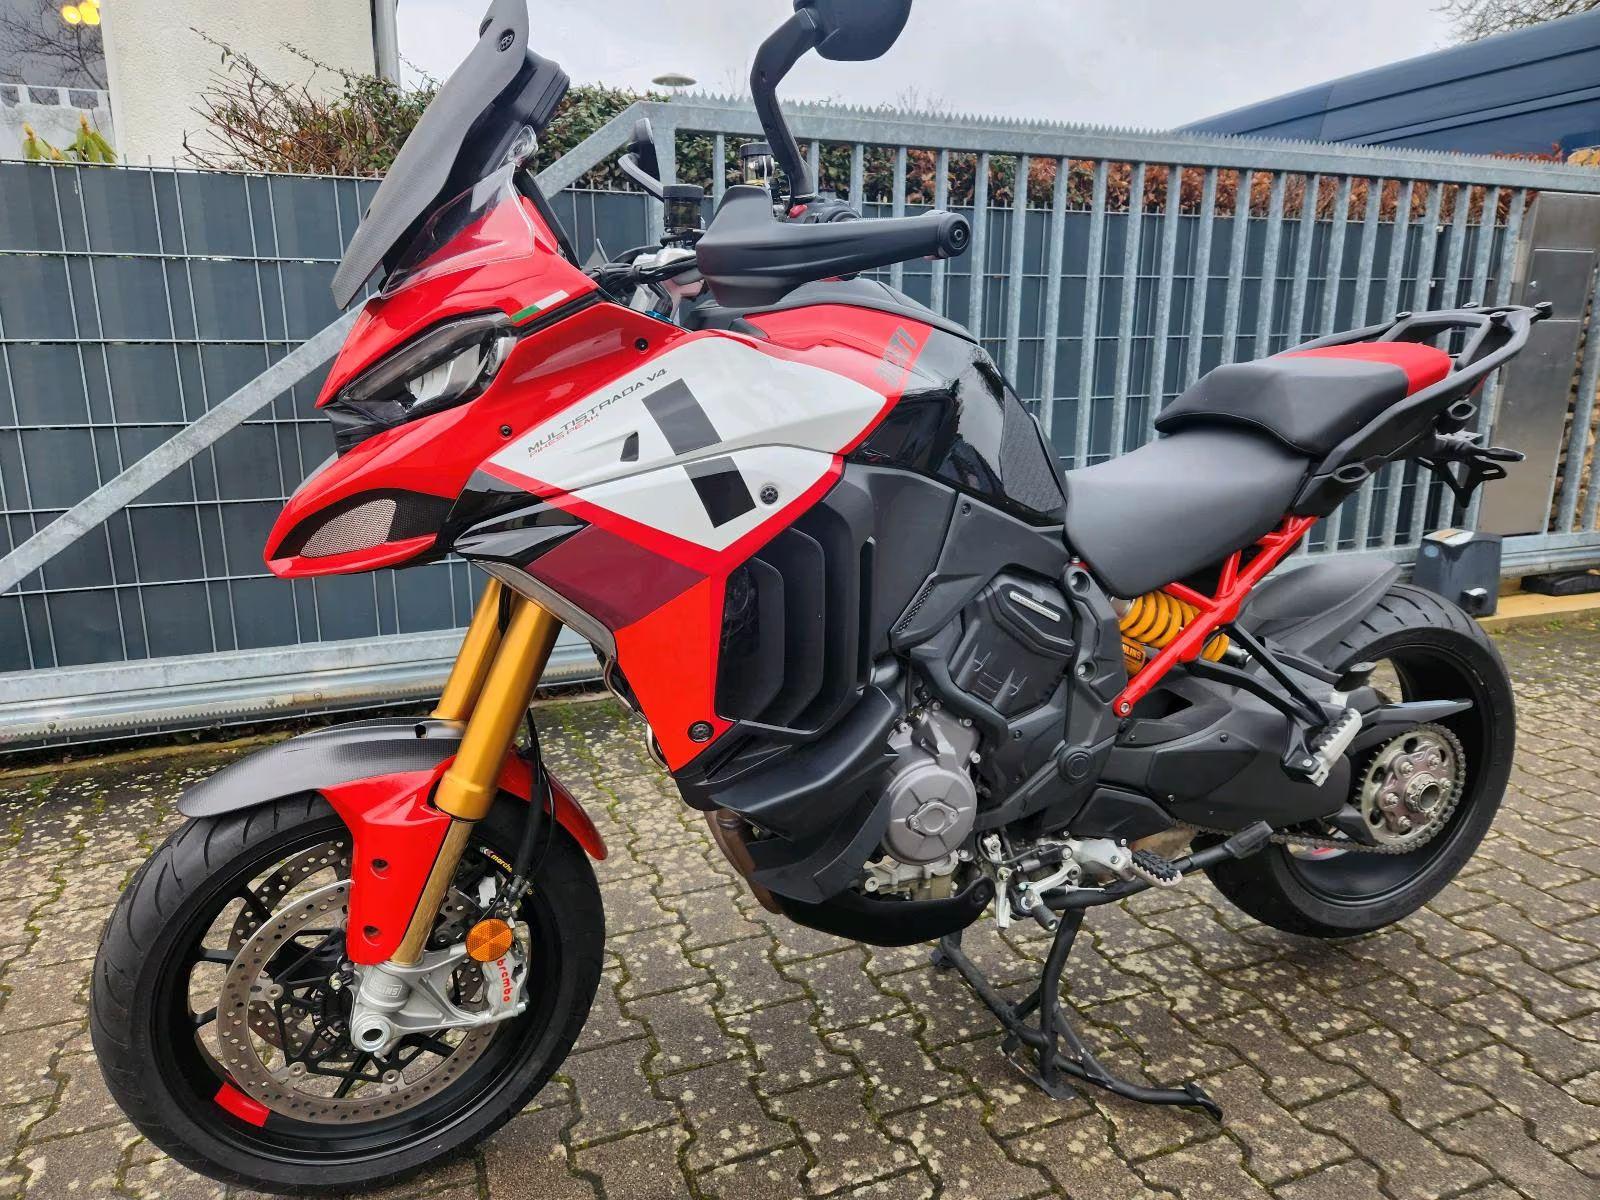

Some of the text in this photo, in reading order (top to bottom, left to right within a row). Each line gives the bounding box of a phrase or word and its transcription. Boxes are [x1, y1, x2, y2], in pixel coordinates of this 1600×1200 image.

[528, 368, 668, 453] MULTISTRADA V4
[566, 412, 600, 435] PEAK
[490, 854, 513, 873] marche
[497, 957, 513, 1002] brembo
